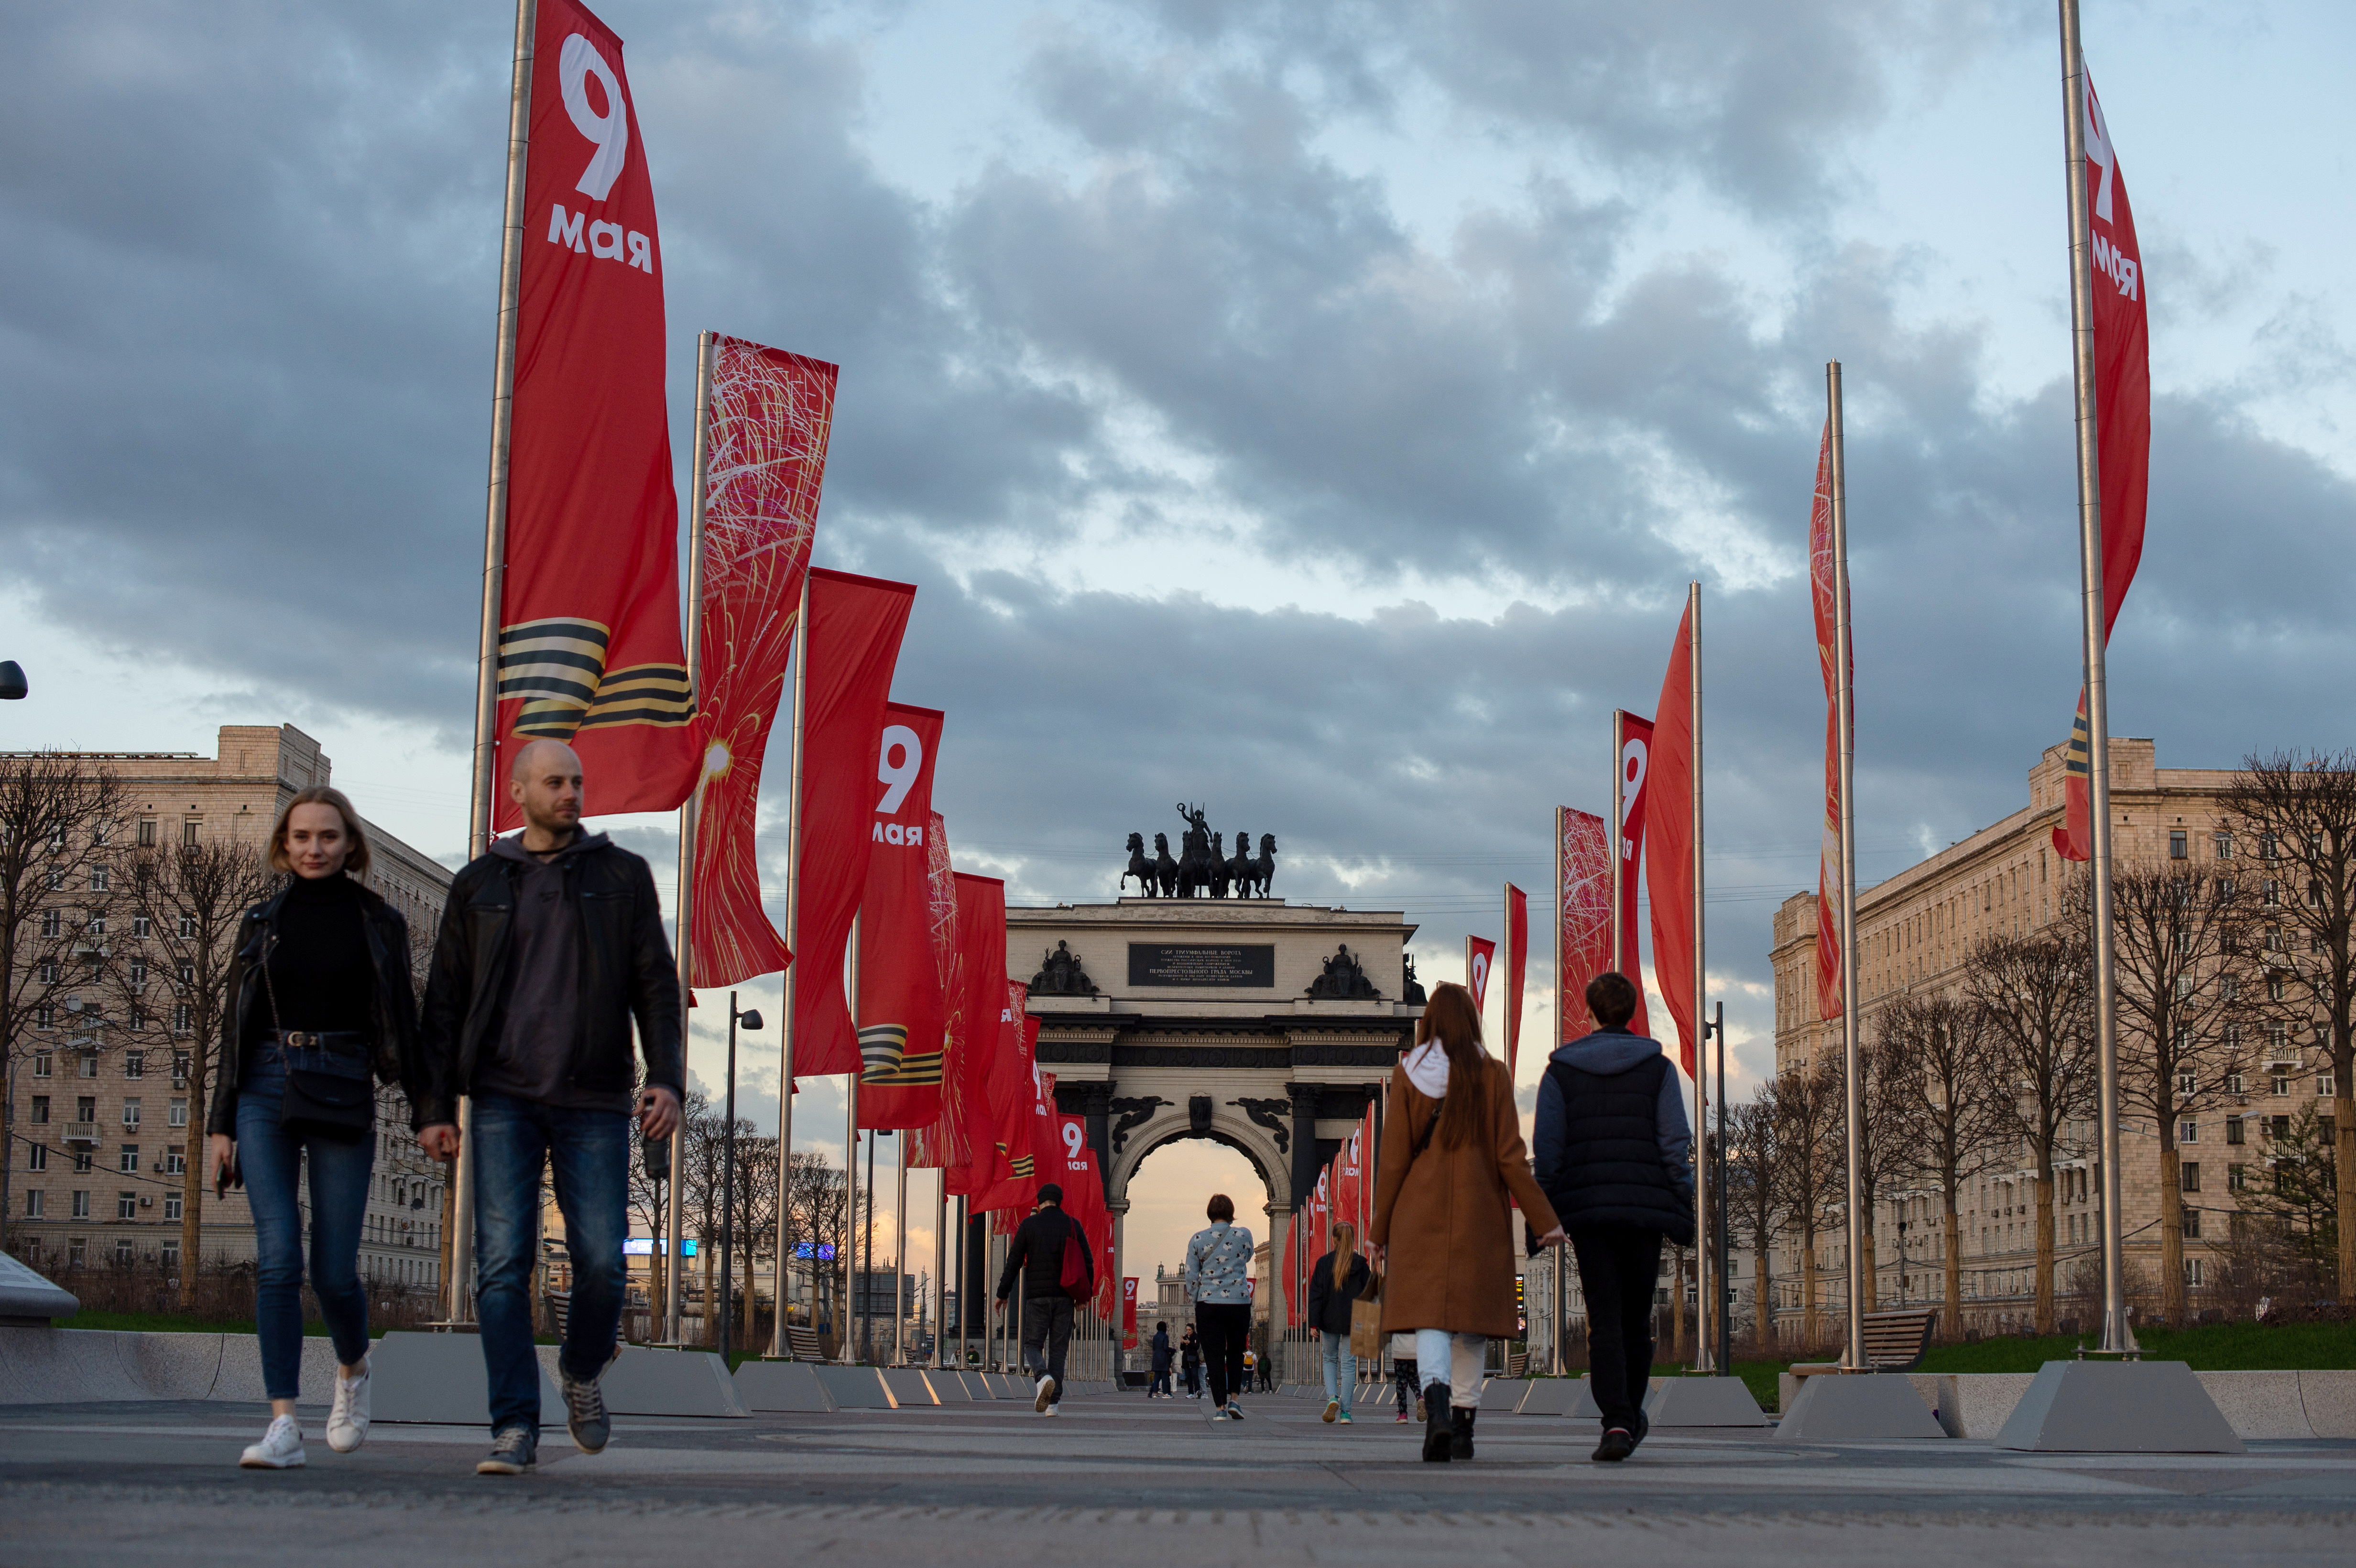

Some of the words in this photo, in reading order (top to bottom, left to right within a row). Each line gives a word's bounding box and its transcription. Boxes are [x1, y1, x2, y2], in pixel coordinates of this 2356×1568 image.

[559, 33, 628, 201] 9
[2081, 48, 2114, 227] 9
[547, 203, 653, 274] мая
[2092, 229, 2137, 302] мая
[875, 725, 922, 814] 9
[1623, 738, 1647, 827] 9
[1062, 1122, 1083, 1158] 9
[1125, 1280, 1135, 1295] 9
